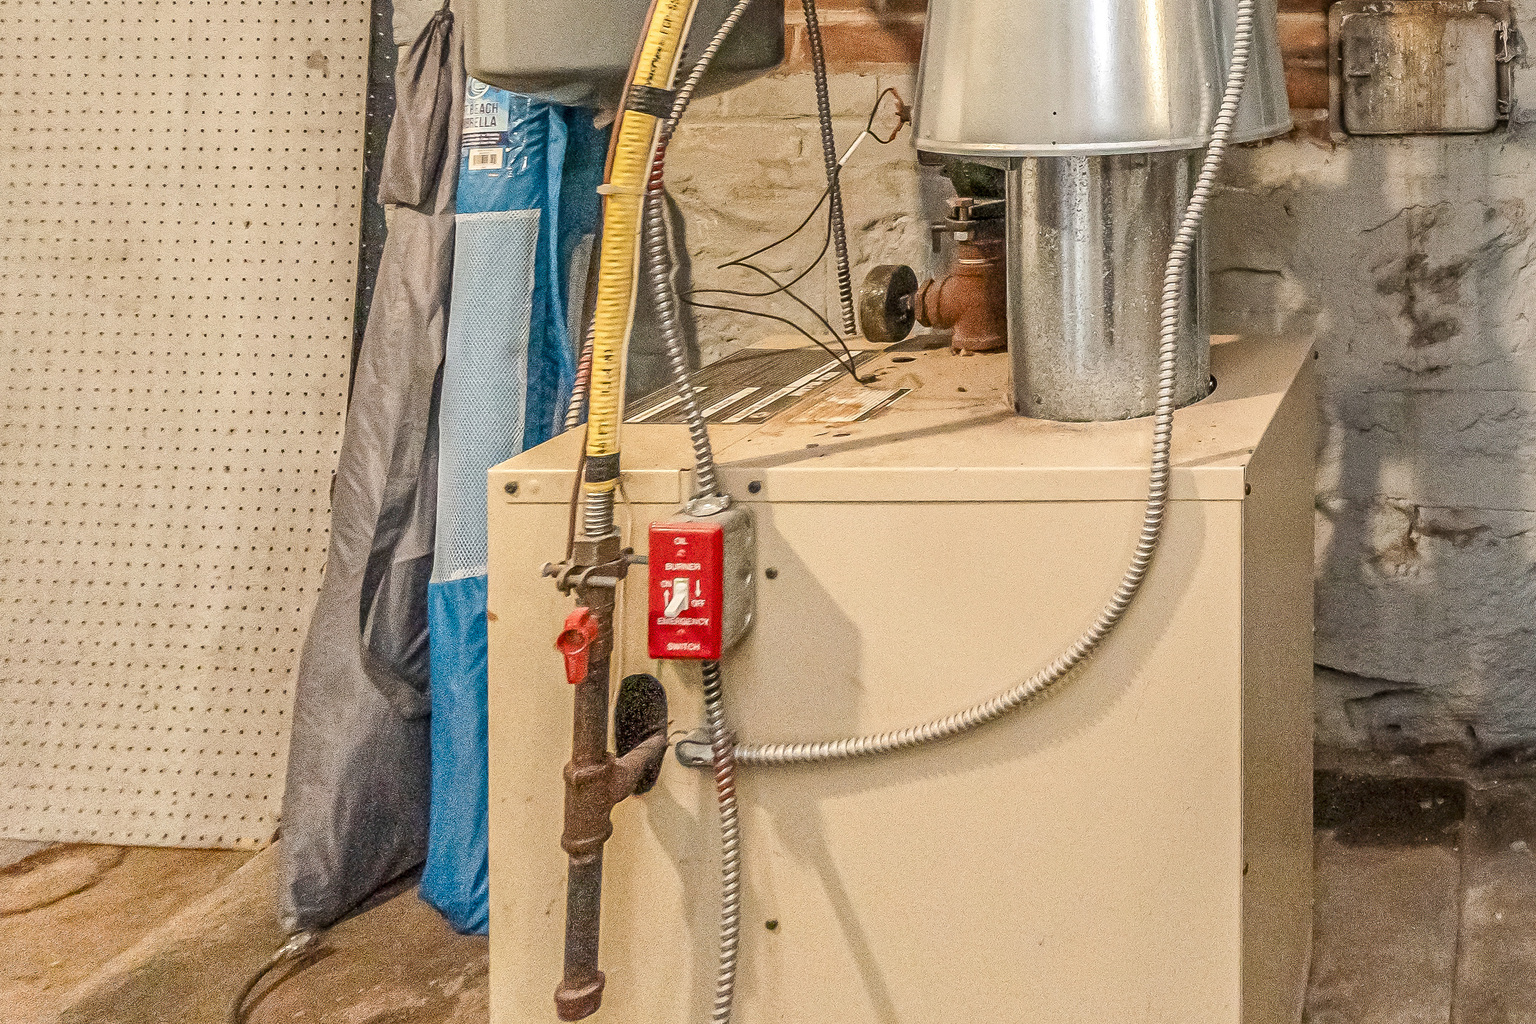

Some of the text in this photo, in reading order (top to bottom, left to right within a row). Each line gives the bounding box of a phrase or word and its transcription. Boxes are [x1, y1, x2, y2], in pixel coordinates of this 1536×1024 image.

[470, 102, 498, 114] BEACH
[674, 536, 688, 545] OIL
[664, 562, 701, 570] BURNER
[691, 599, 706, 607] OFF
[666, 642, 700, 651] SWITCH
